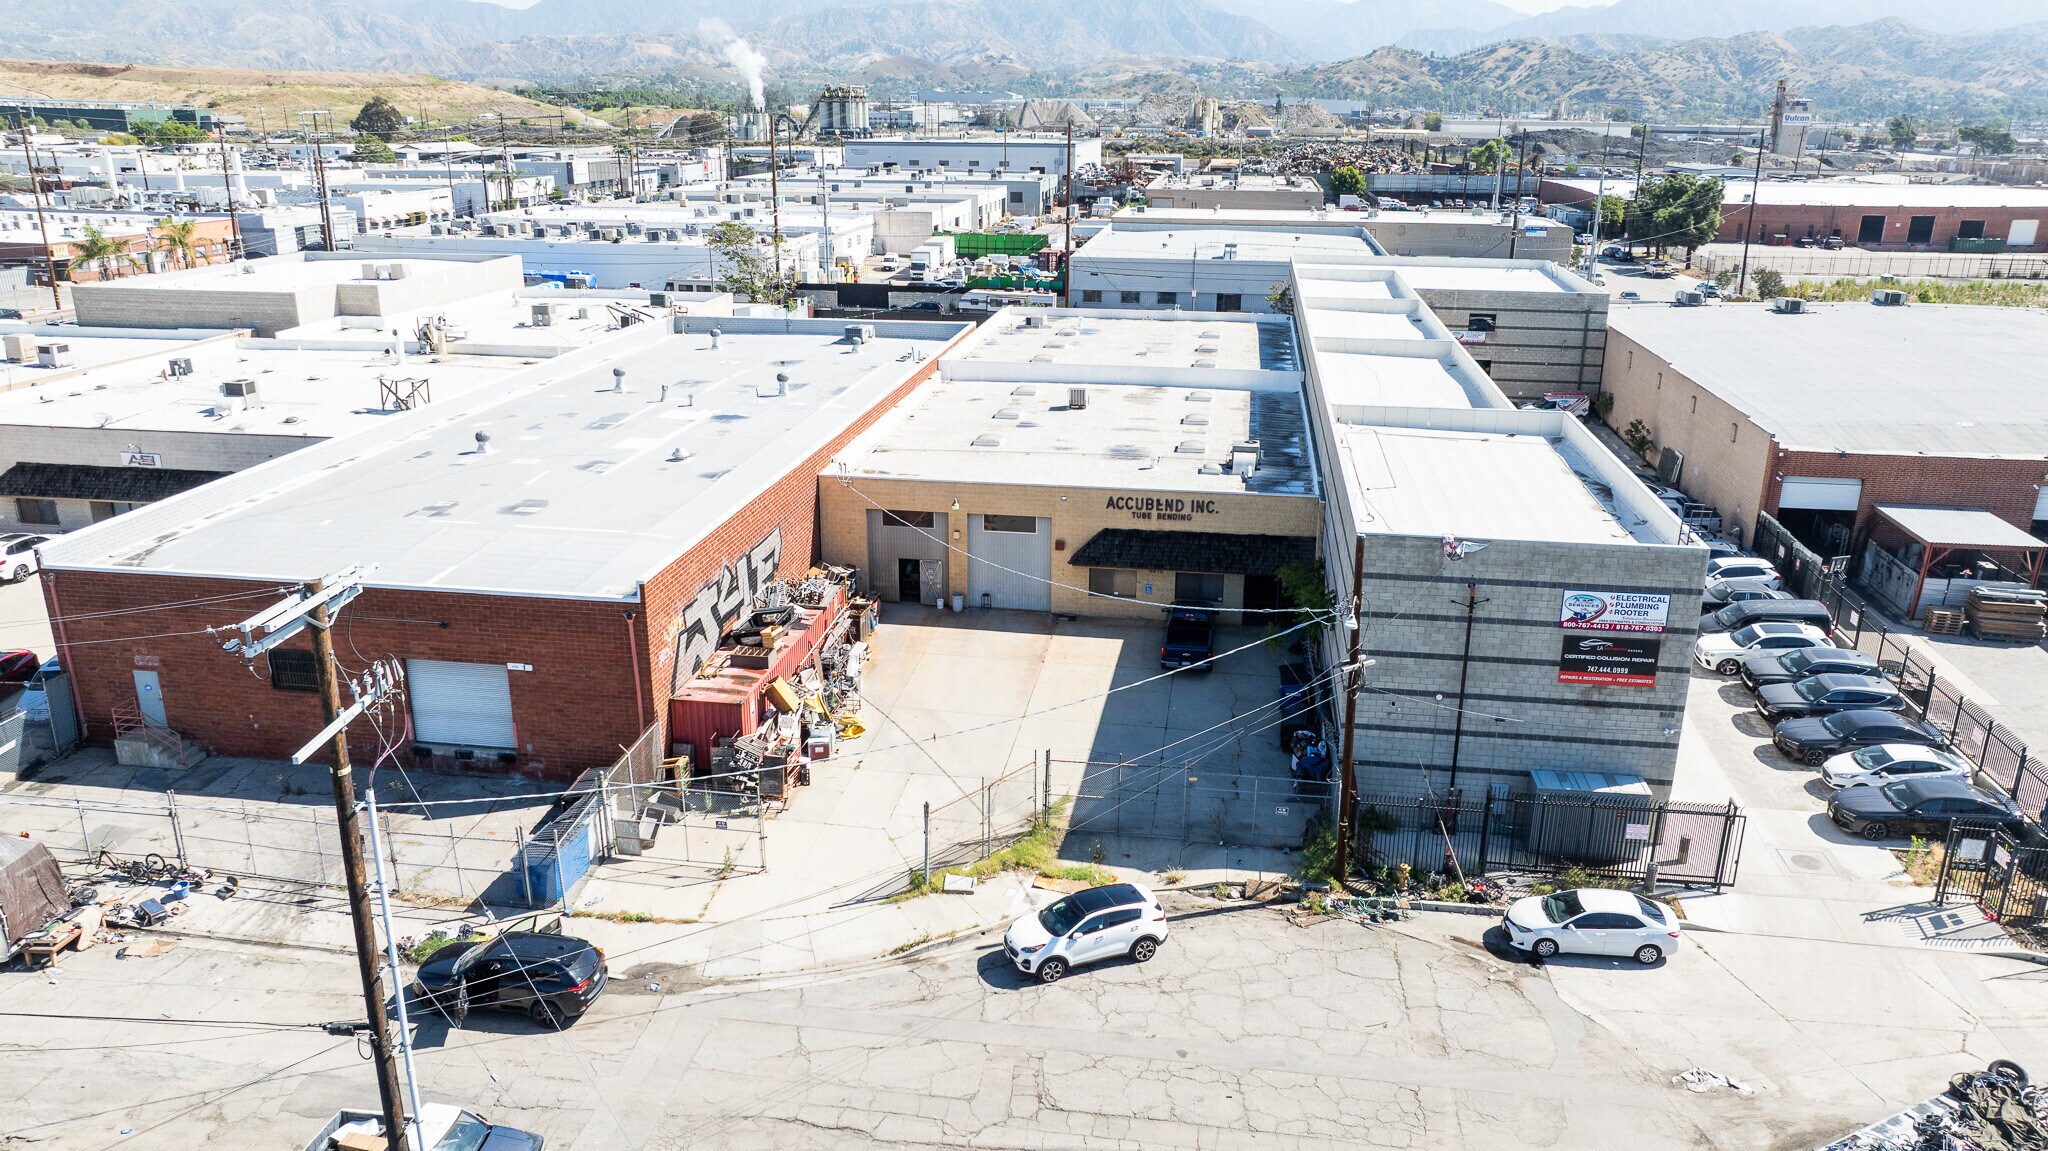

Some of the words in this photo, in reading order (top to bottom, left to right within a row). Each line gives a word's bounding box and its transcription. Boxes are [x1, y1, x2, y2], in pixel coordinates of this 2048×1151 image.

[1106, 496, 1185, 512] ACCUBEND
[1191, 499, 1219, 514] INC.
[1131, 511, 1152, 520] TUBE
[1156, 512, 1193, 521] BENDING
[1616, 595, 1668, 604] ELECTRICAL
[1614, 602, 1660, 610] PLUMBING
[1613, 609, 1649, 617] ROOTER
[1563, 621, 1610, 630] 800-767-4413
[1587, 665, 1629, 674] 747.444.0999
